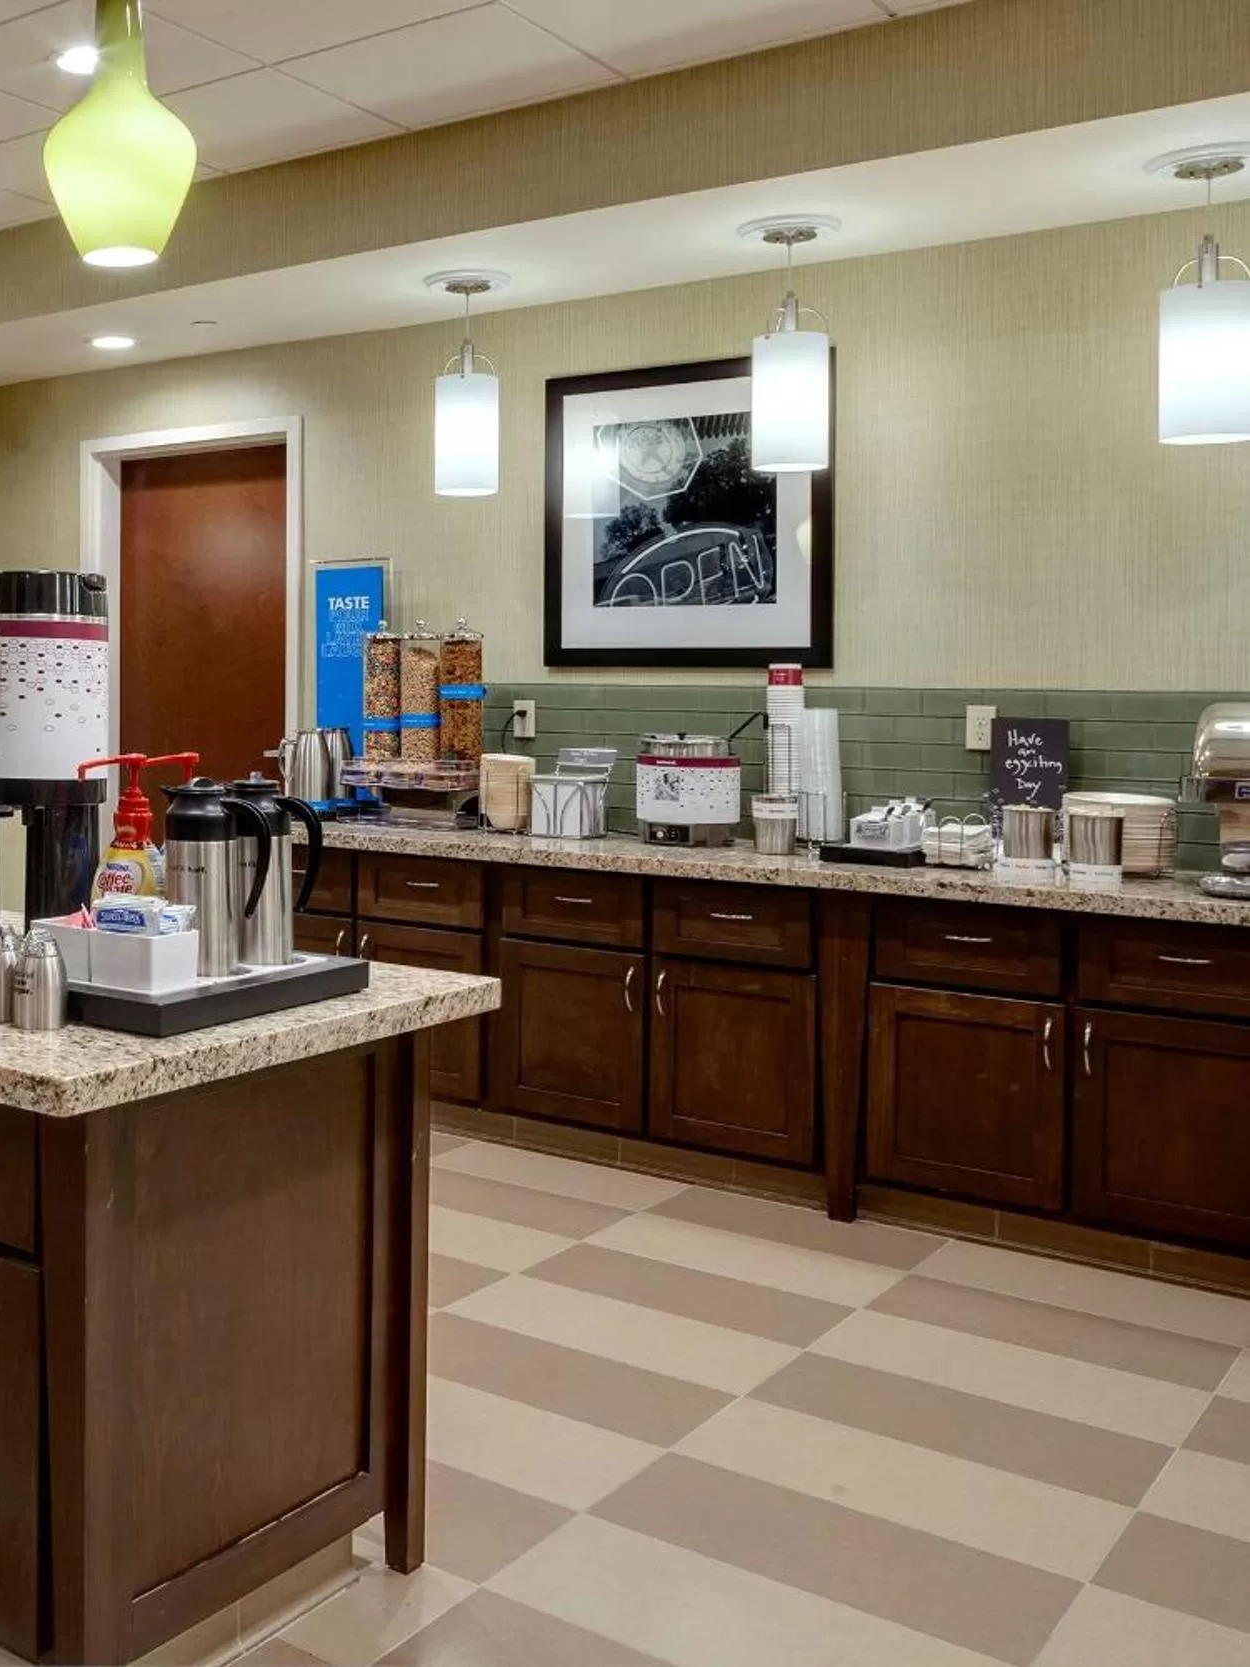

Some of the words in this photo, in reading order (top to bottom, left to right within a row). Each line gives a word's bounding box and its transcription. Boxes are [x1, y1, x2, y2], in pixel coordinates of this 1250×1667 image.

[328, 596, 369, 610] TASTE
[1007, 728, 1043, 748] Have
[1017, 747, 1036, 757] an
[1015, 777, 1042, 799] Day
